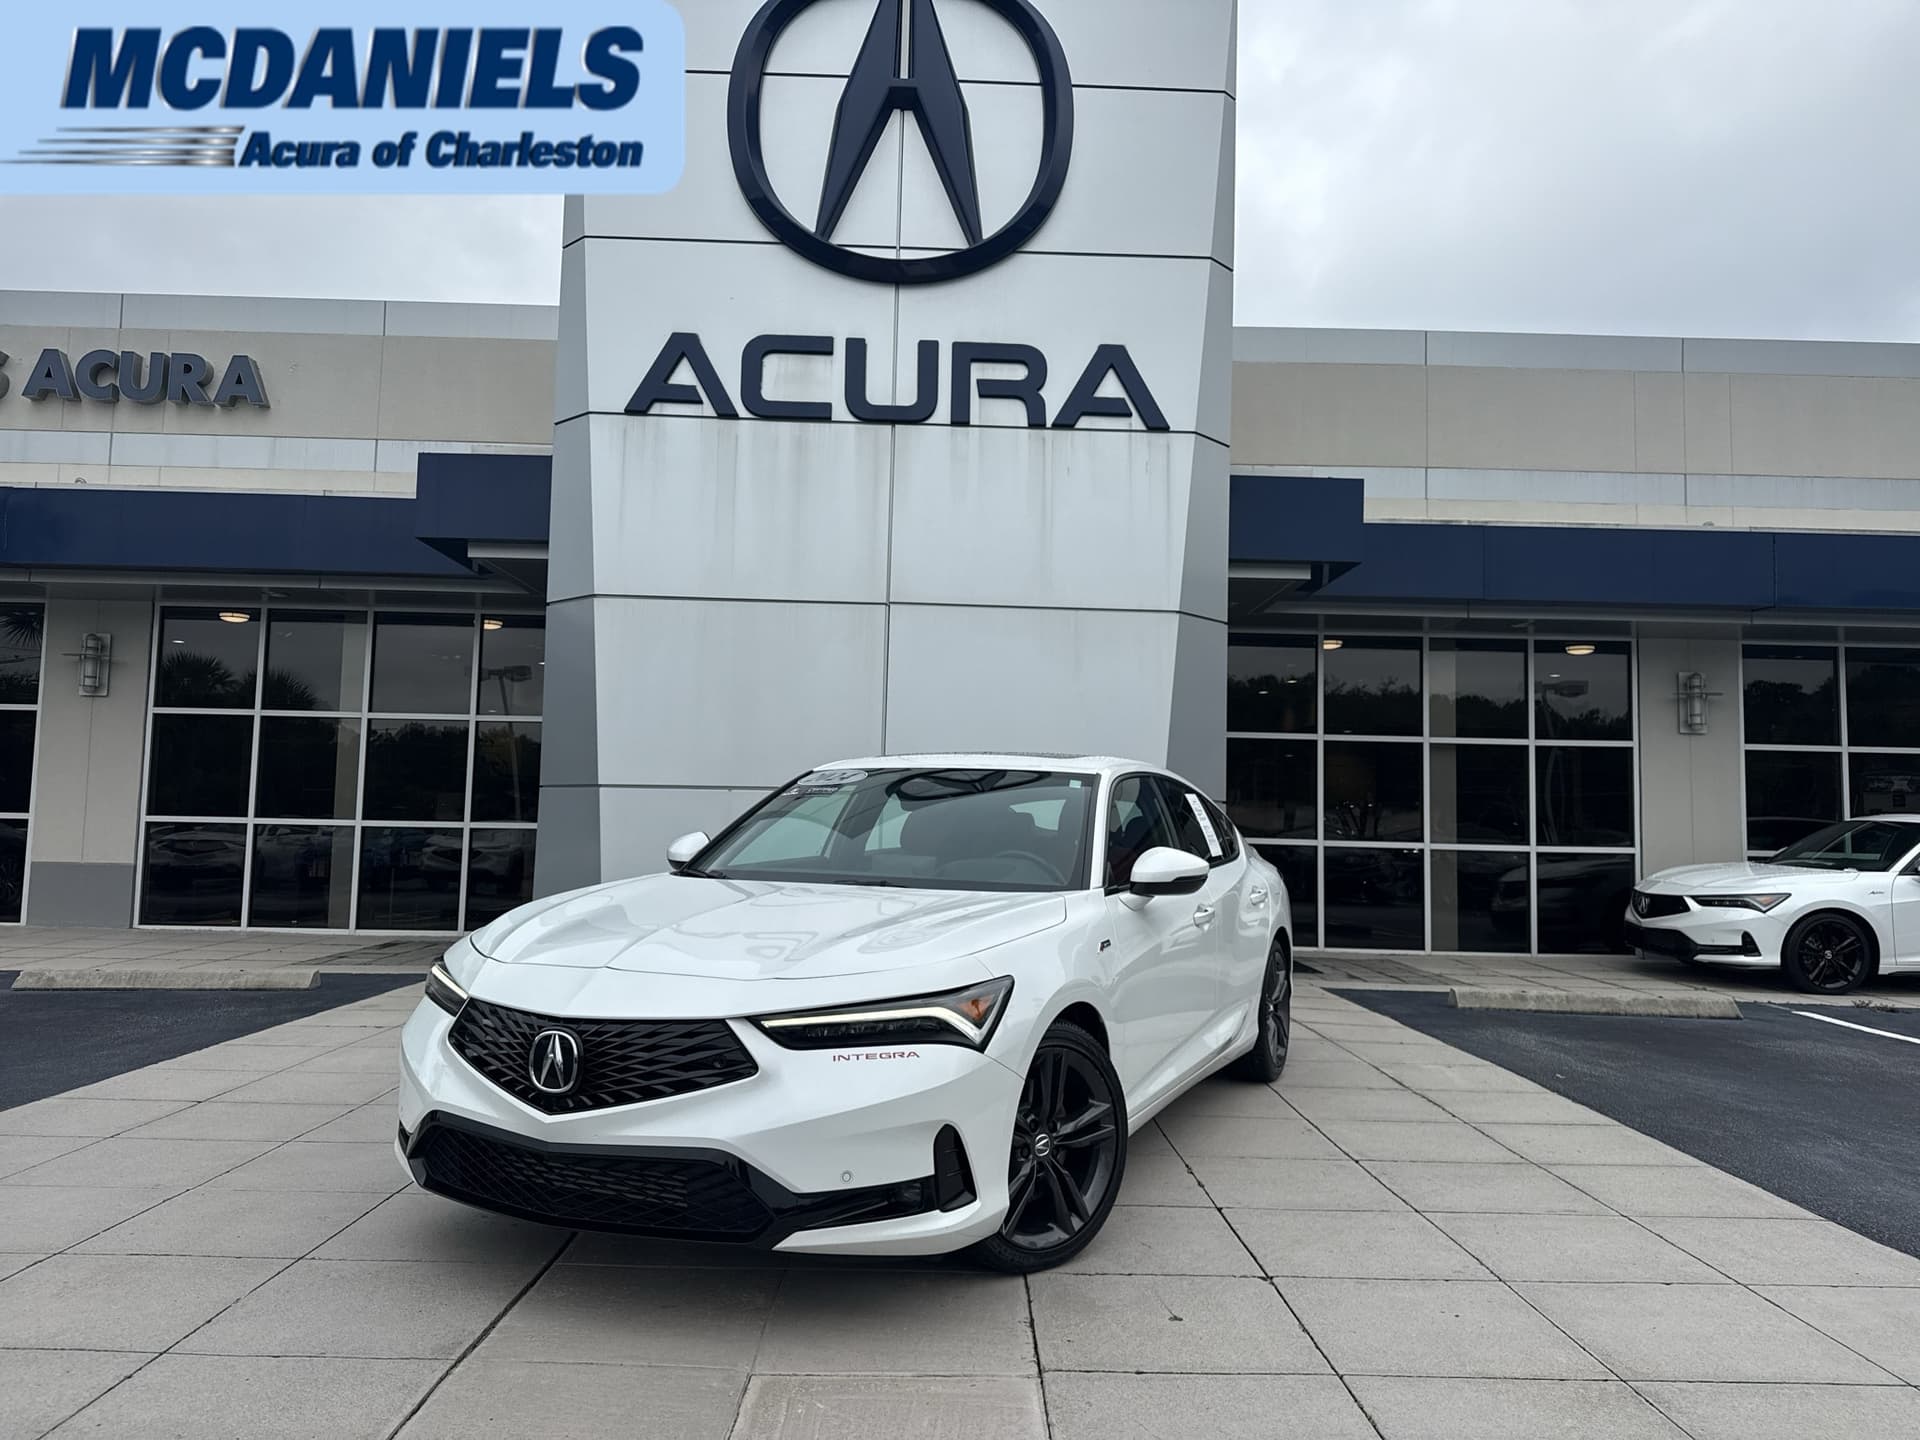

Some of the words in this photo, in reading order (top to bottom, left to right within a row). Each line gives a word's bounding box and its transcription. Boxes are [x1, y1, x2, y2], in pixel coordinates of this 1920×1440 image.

[22, 348, 271, 409] ACURA
[624, 331, 1170, 431] ACURA
[832, 1051, 920, 1062] INTEGRA
